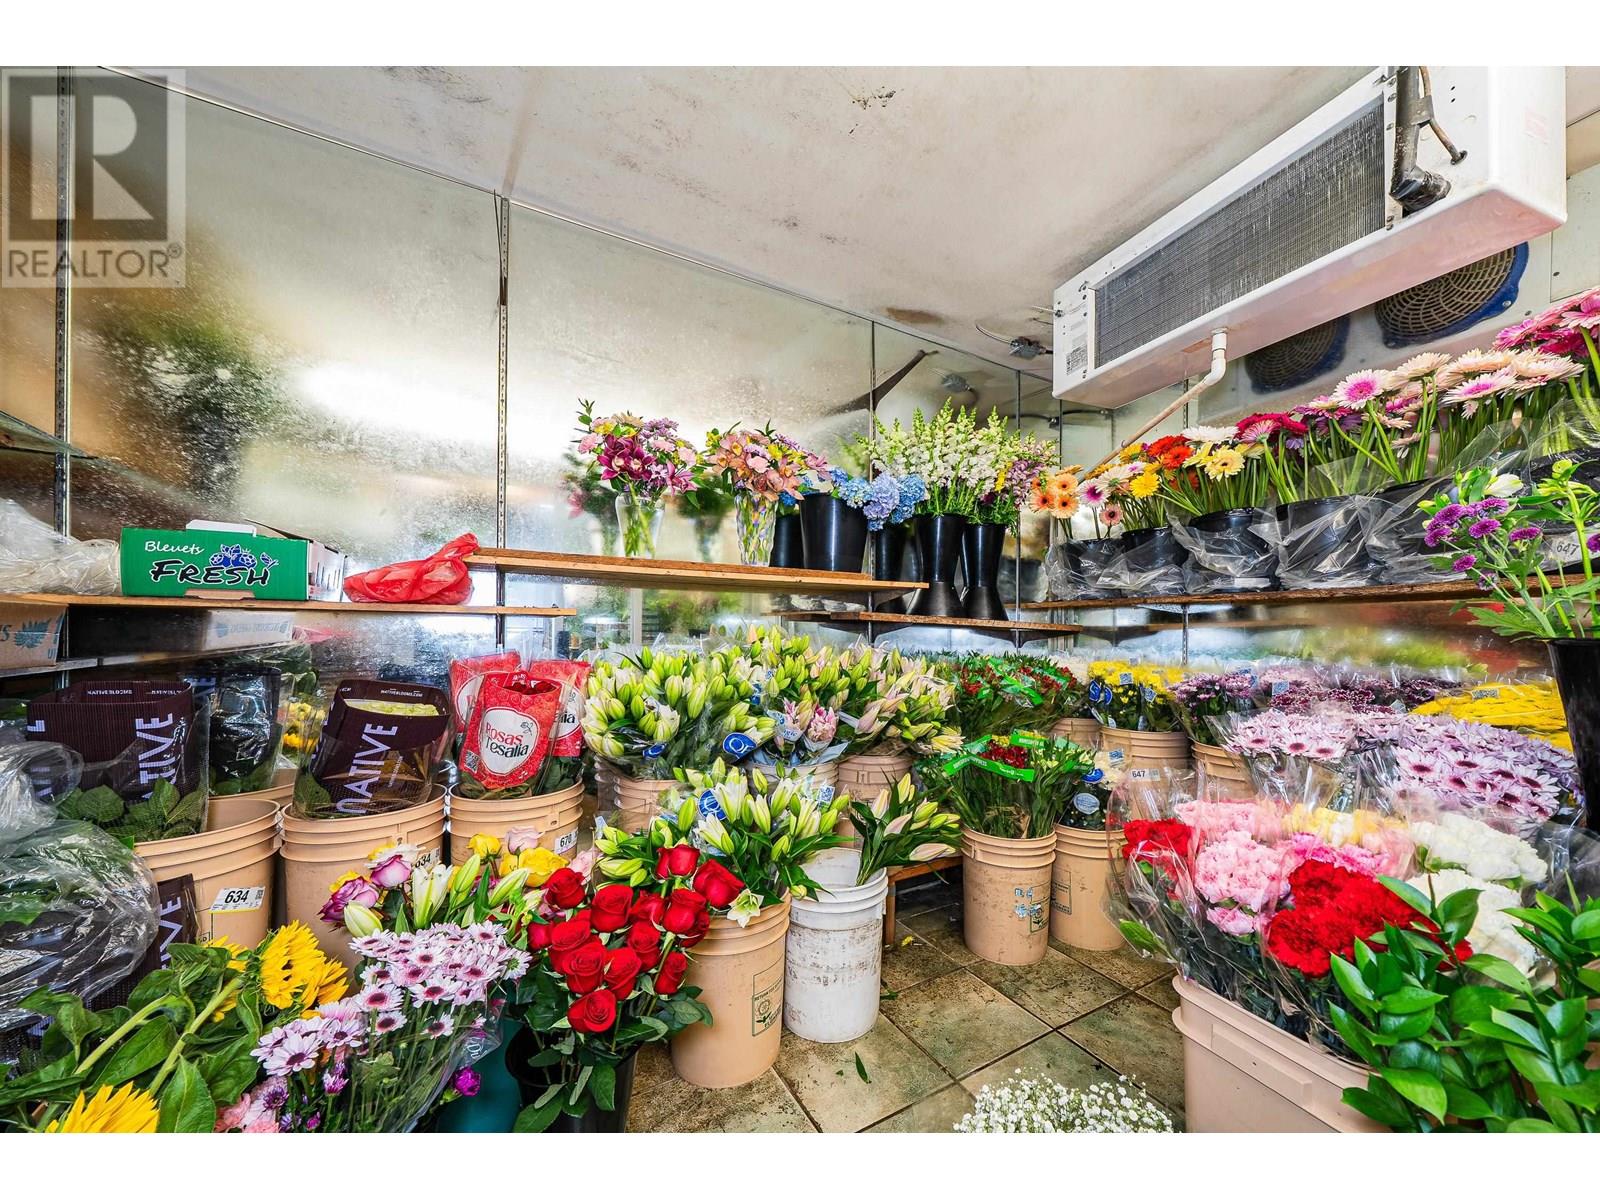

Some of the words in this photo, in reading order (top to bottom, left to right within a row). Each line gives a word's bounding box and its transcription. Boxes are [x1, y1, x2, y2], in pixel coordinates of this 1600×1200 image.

[145, 541, 204, 555] Bleuets
[150, 559, 270, 587] FRESH
[1132, 770, 1146, 778] 647
[225, 890, 249, 903] 634
